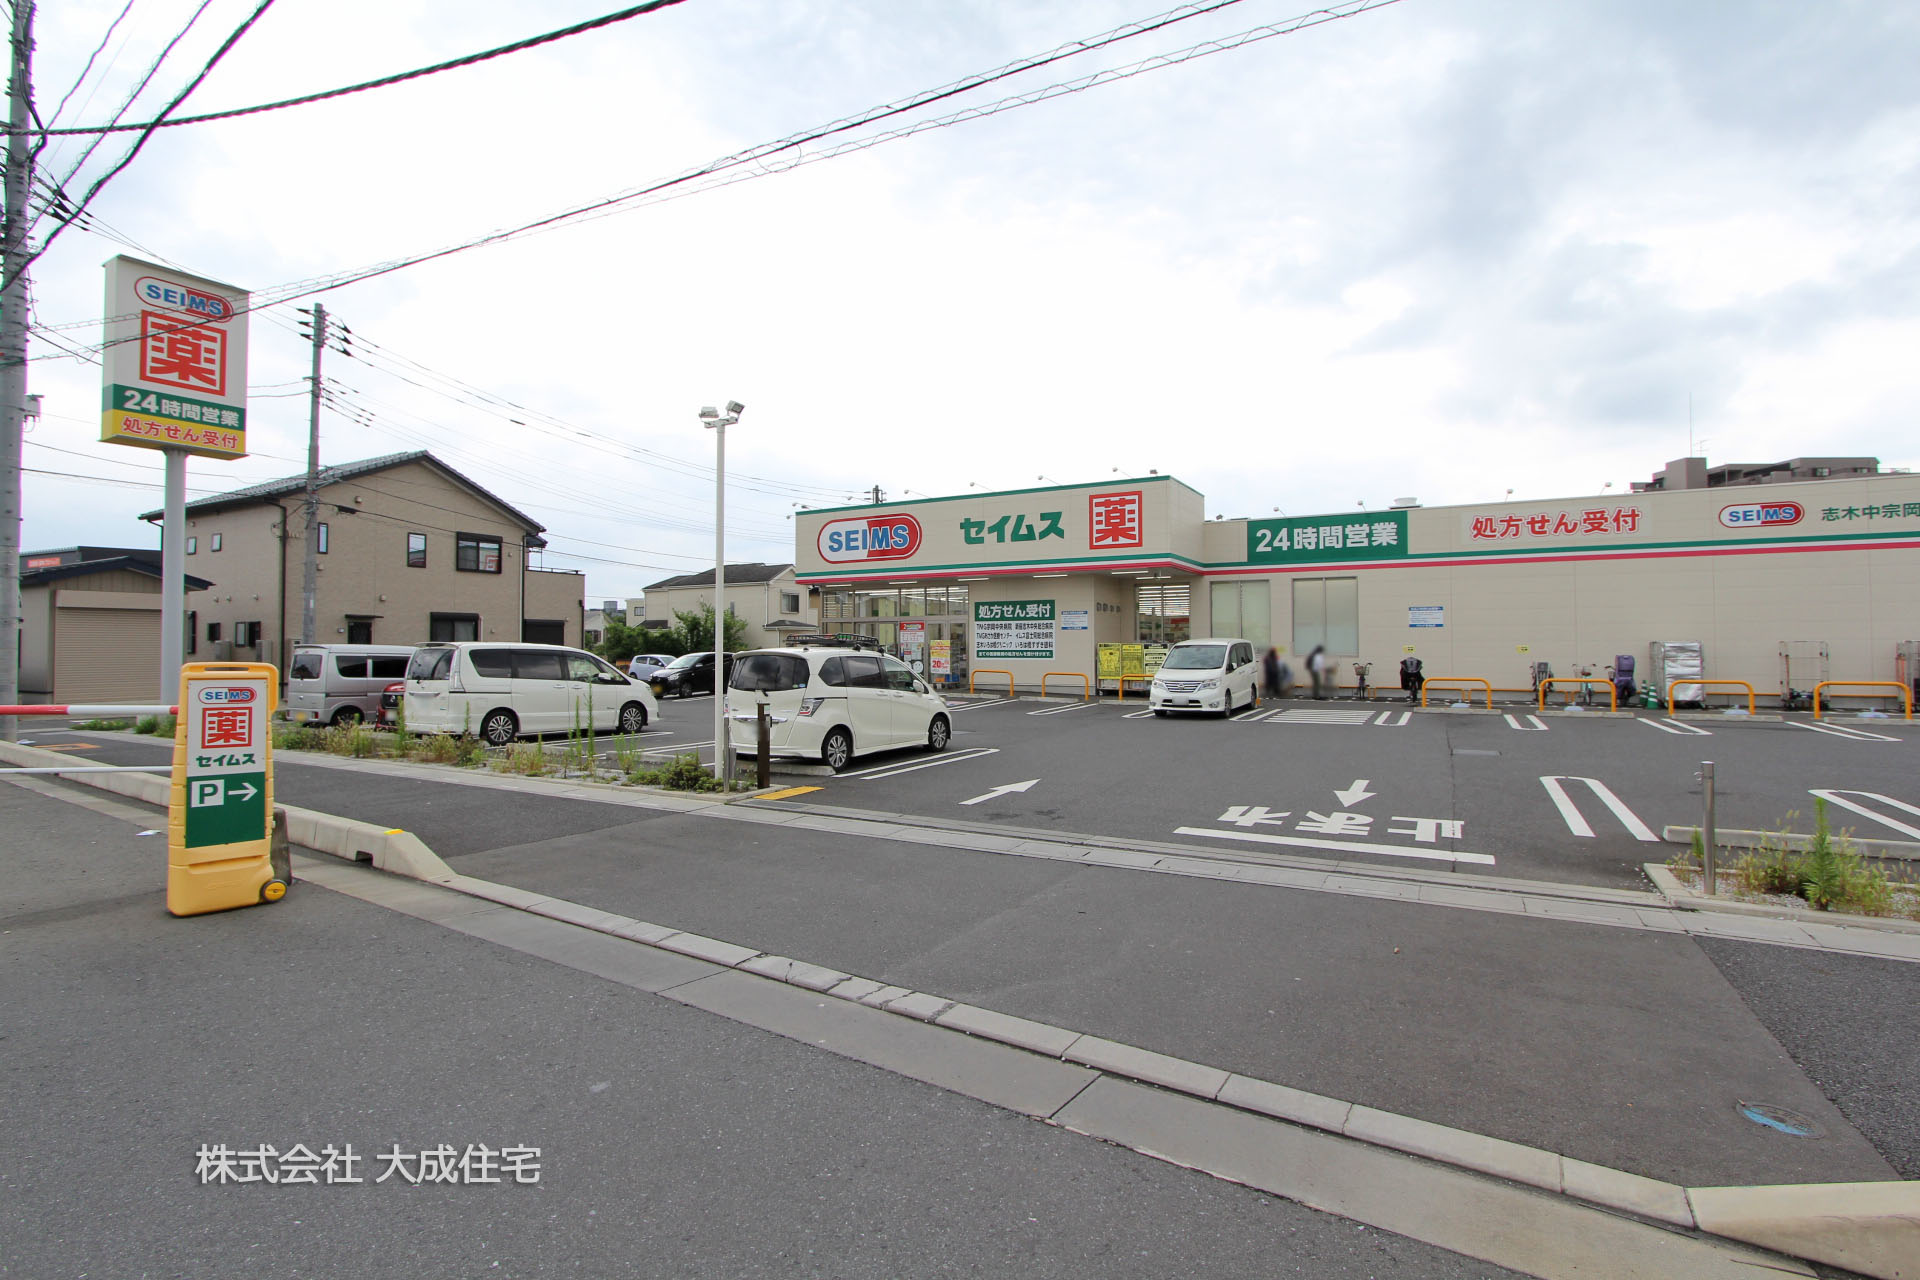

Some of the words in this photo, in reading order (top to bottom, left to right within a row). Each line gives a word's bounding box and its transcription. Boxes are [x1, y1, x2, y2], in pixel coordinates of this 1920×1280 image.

[146, 284, 223, 316] SEIMS
[147, 319, 220, 390] 薬
[123, 389, 240, 428] 24時間営業
[122, 416, 239, 449] 処方せん受付
[959, 511, 1065, 545] セイムス
[1094, 496, 1138, 544] 薬
[1471, 509, 1642, 541] 処方せん受付
[1727, 507, 1796, 523] SEIMS
[1820, 502, 1920, 522] 志木中宗岡
[828, 525, 910, 552] SEIMS
[1255, 521, 1399, 553] 24時間営業
[978, 603, 1051, 619] 処方せん受付
[204, 690, 250, 701] SEIMS
[206, 710, 248, 745] 薬
[196, 752, 256, 768] セイムス
[199, 782, 219, 805] P
